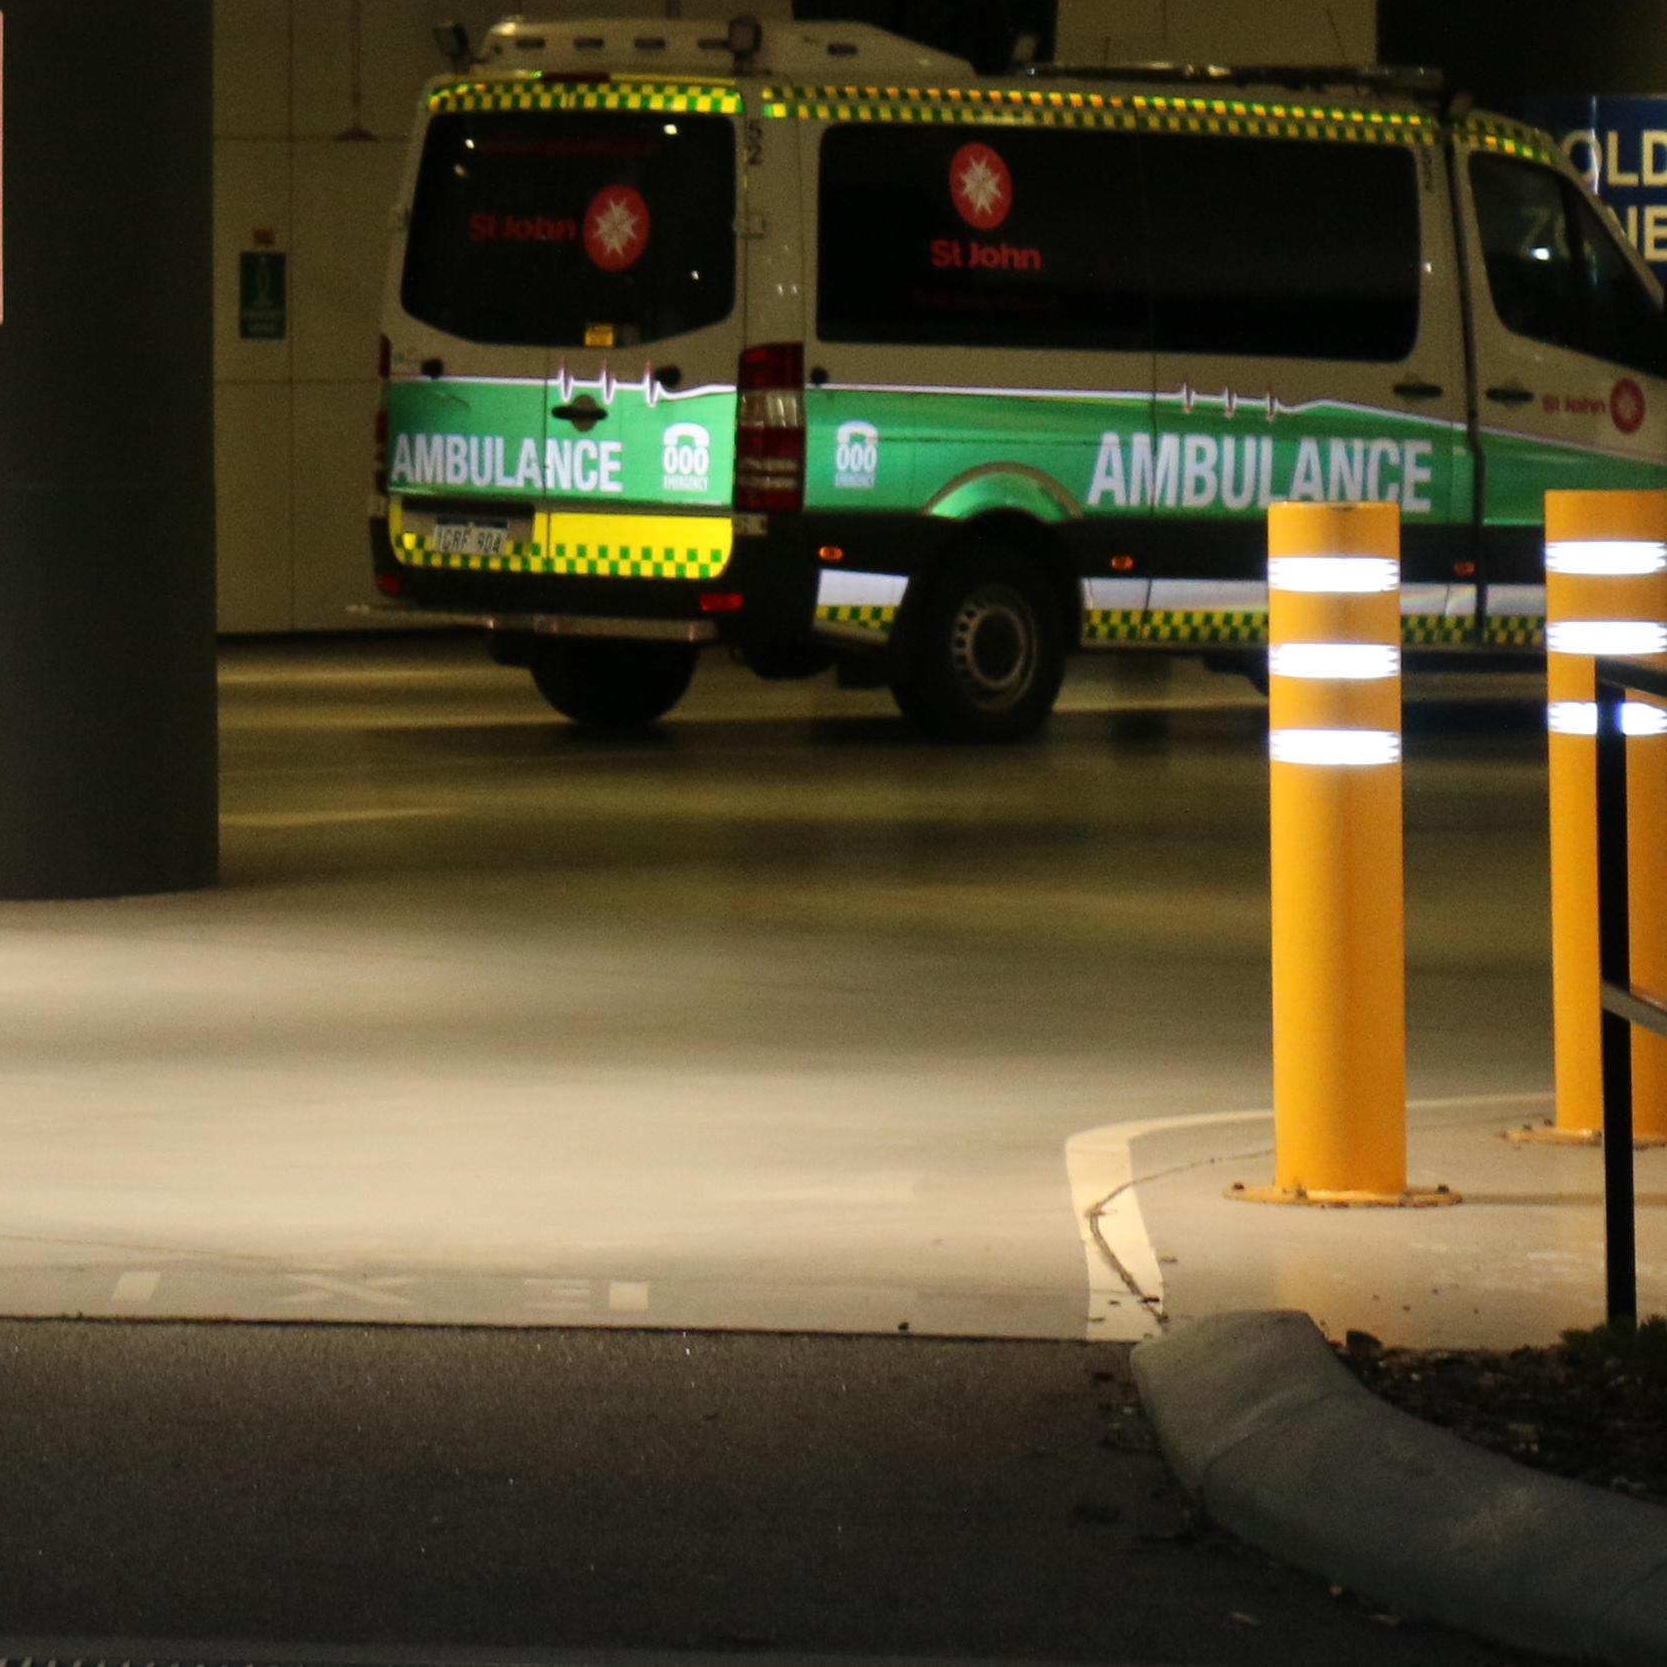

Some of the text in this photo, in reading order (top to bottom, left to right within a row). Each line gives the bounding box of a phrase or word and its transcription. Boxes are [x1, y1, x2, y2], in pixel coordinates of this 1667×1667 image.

[1560, 129, 1667, 186] OLD
[931, 238, 1043, 271] St John
[392, 431, 623, 492] AMBULANCE
[663, 444, 710, 475] 000
[836, 444, 877, 473] 000
[1088, 432, 1433, 511] AMBULANCE
